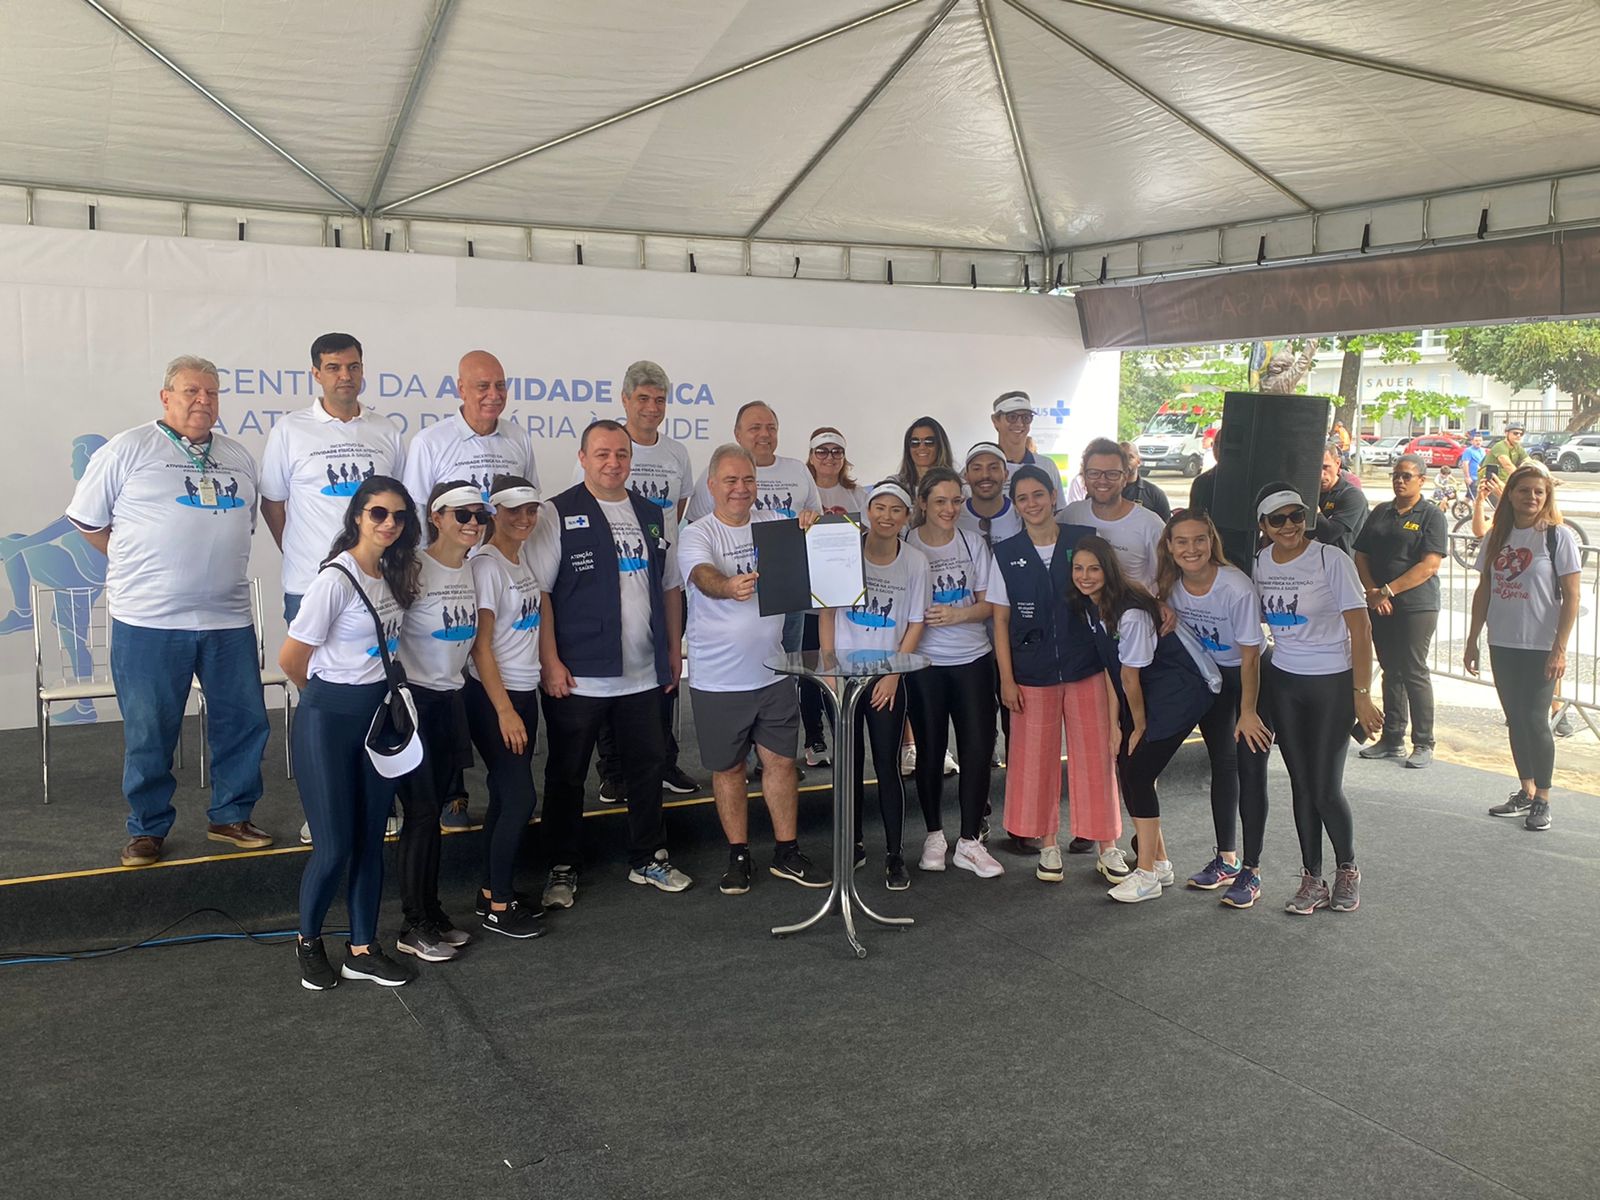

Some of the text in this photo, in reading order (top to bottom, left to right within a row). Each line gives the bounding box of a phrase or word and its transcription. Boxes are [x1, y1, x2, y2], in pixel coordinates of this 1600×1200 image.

[380, 373, 427, 398] DA
[1366, 377, 1414, 388] SAUER
[570, 551, 594, 560] ATENÇÃO
